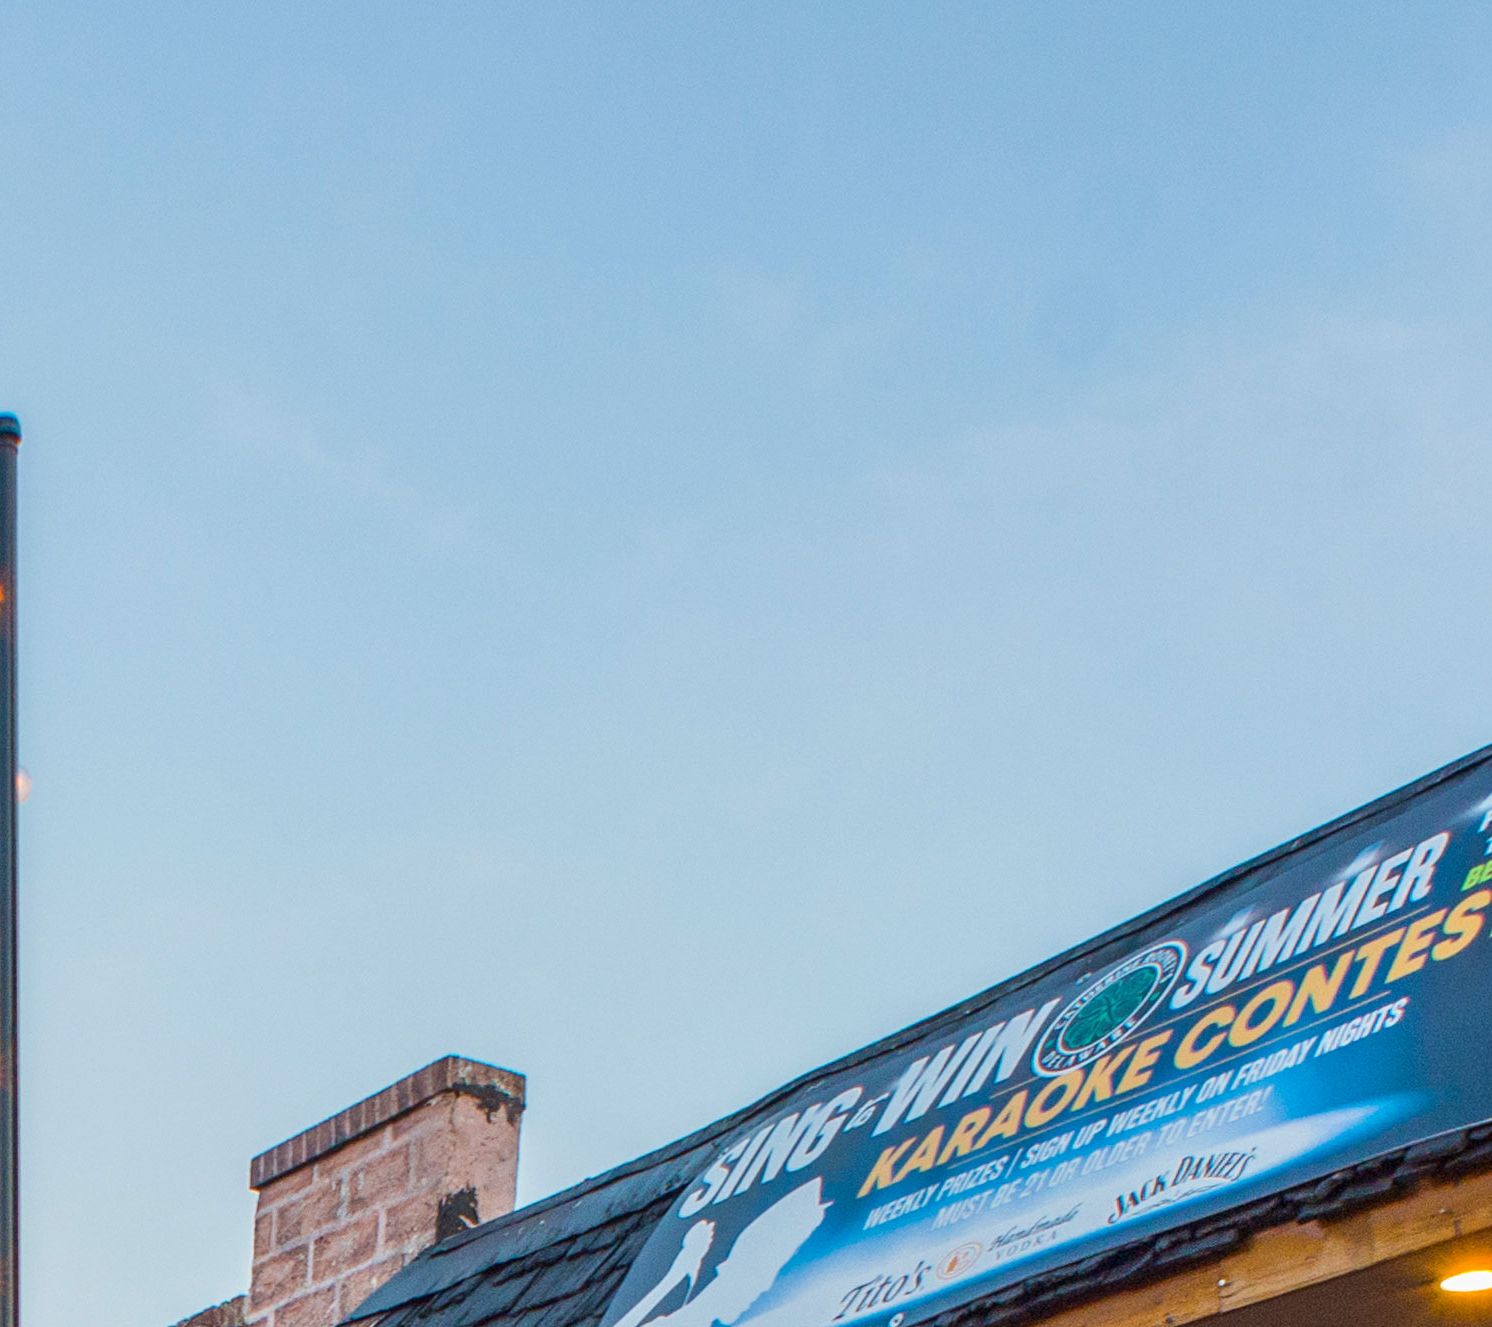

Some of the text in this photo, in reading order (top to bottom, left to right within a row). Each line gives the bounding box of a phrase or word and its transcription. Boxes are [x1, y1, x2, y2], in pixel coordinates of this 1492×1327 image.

[677, 830, 1450, 1220] SING WIN SUMMER
[856, 1030, 1175, 1199] KARAOKE
[863, 996, 1410, 1230] WEEKLY PRIZES SIGN UP WEEKLY ON FRIDAY NIGHTS
[930, 1085, 1274, 1231] MUST BE 21 OR OLDER TO ENTER!
[994, 1231, 1058, 1260] VODKA
[1107, 1171, 1170, 1224] JACK
[833, 1260, 932, 1321] Tito's
